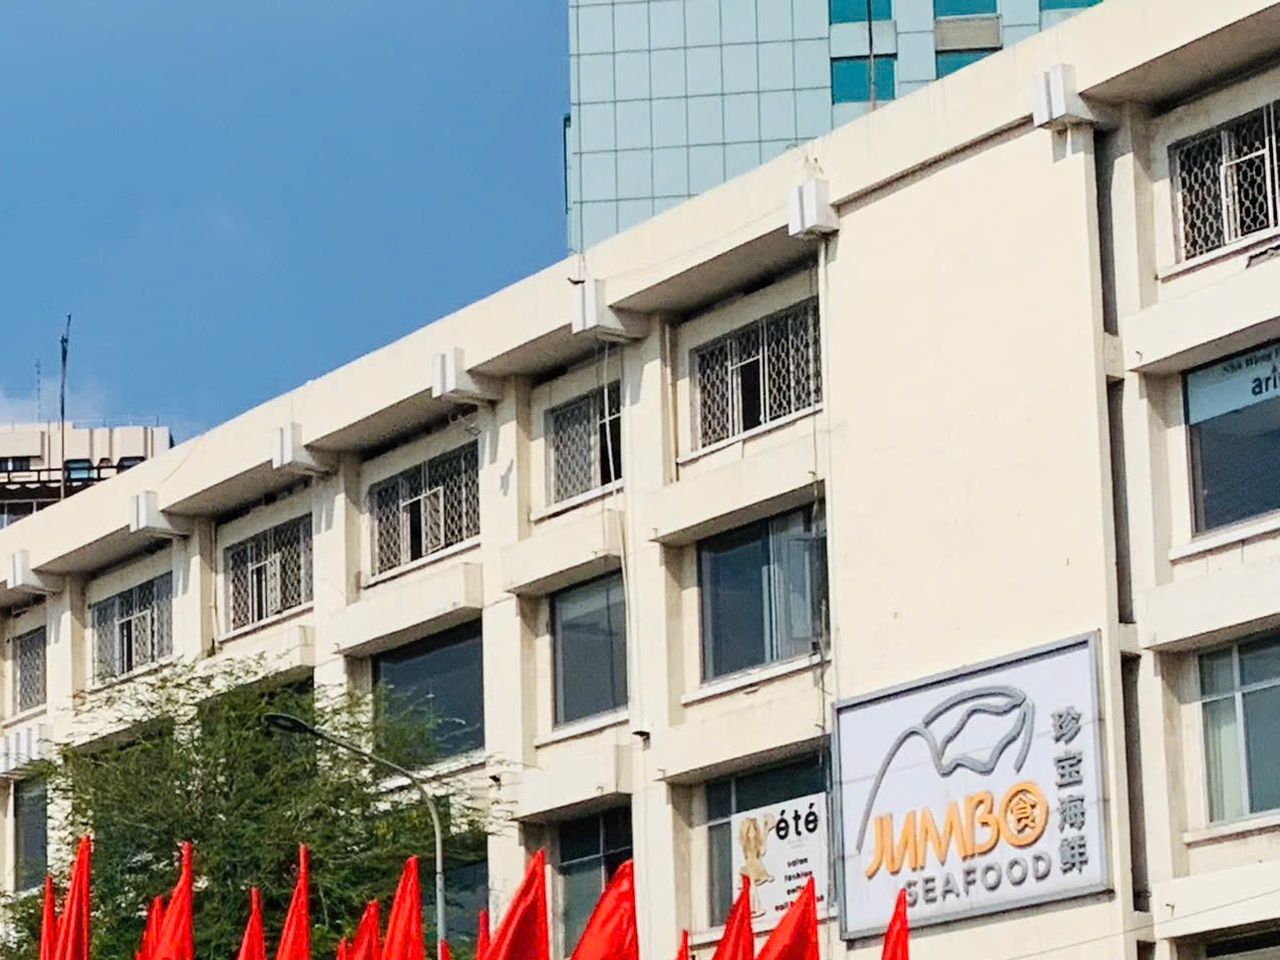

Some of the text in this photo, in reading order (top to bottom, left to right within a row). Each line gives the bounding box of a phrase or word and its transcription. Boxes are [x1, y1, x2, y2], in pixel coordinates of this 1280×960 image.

[775, 803, 818, 840] été
[865, 781, 1049, 880] JUMBO
[906, 852, 1052, 908] SEAFOOD
